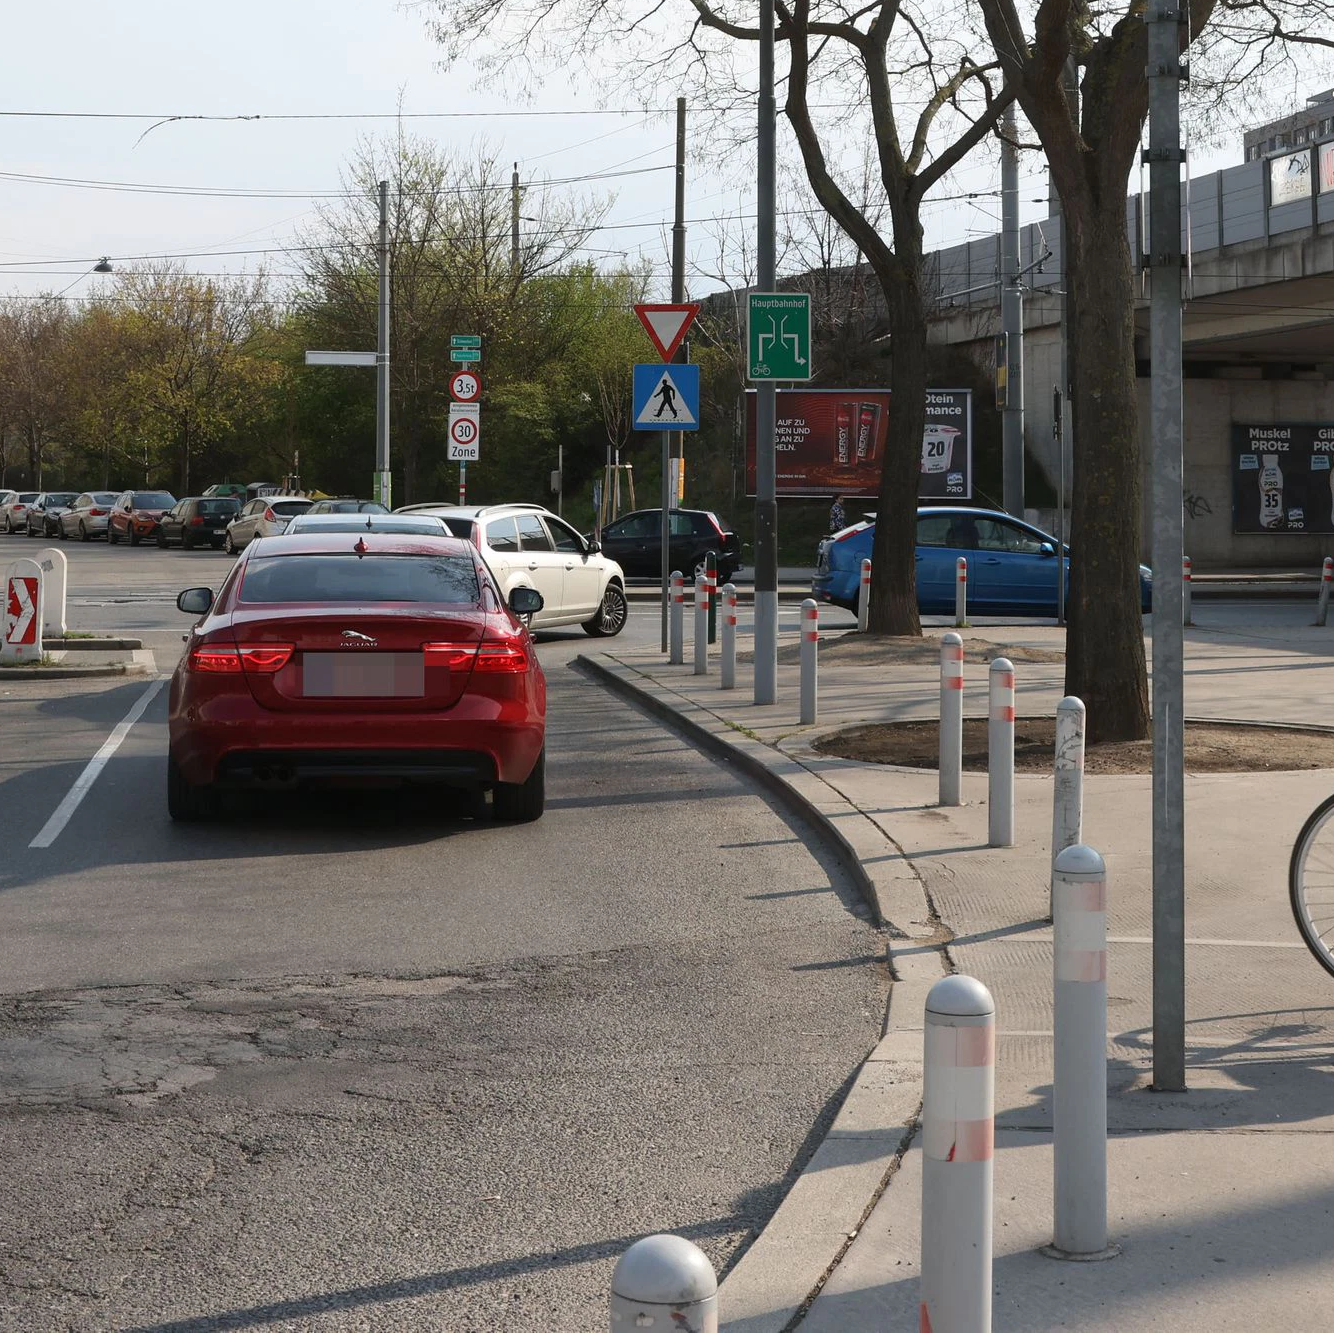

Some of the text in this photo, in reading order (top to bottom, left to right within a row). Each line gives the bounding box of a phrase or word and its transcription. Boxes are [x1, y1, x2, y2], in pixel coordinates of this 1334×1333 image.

[751, 299, 806, 309] Hauptbahnhof
[456, 379, 475, 394] 3,5t
[457, 425, 471, 438] 30
[1249, 428, 1291, 439] Muskel
[839, 426, 848, 463] ENERGY
[858, 424, 869, 457] ENERGY
[1251, 441, 1290, 451] PROtz
[452, 447, 476, 457] Zone
[927, 441, 945, 457] 20
[1264, 494, 1279, 508] 35
